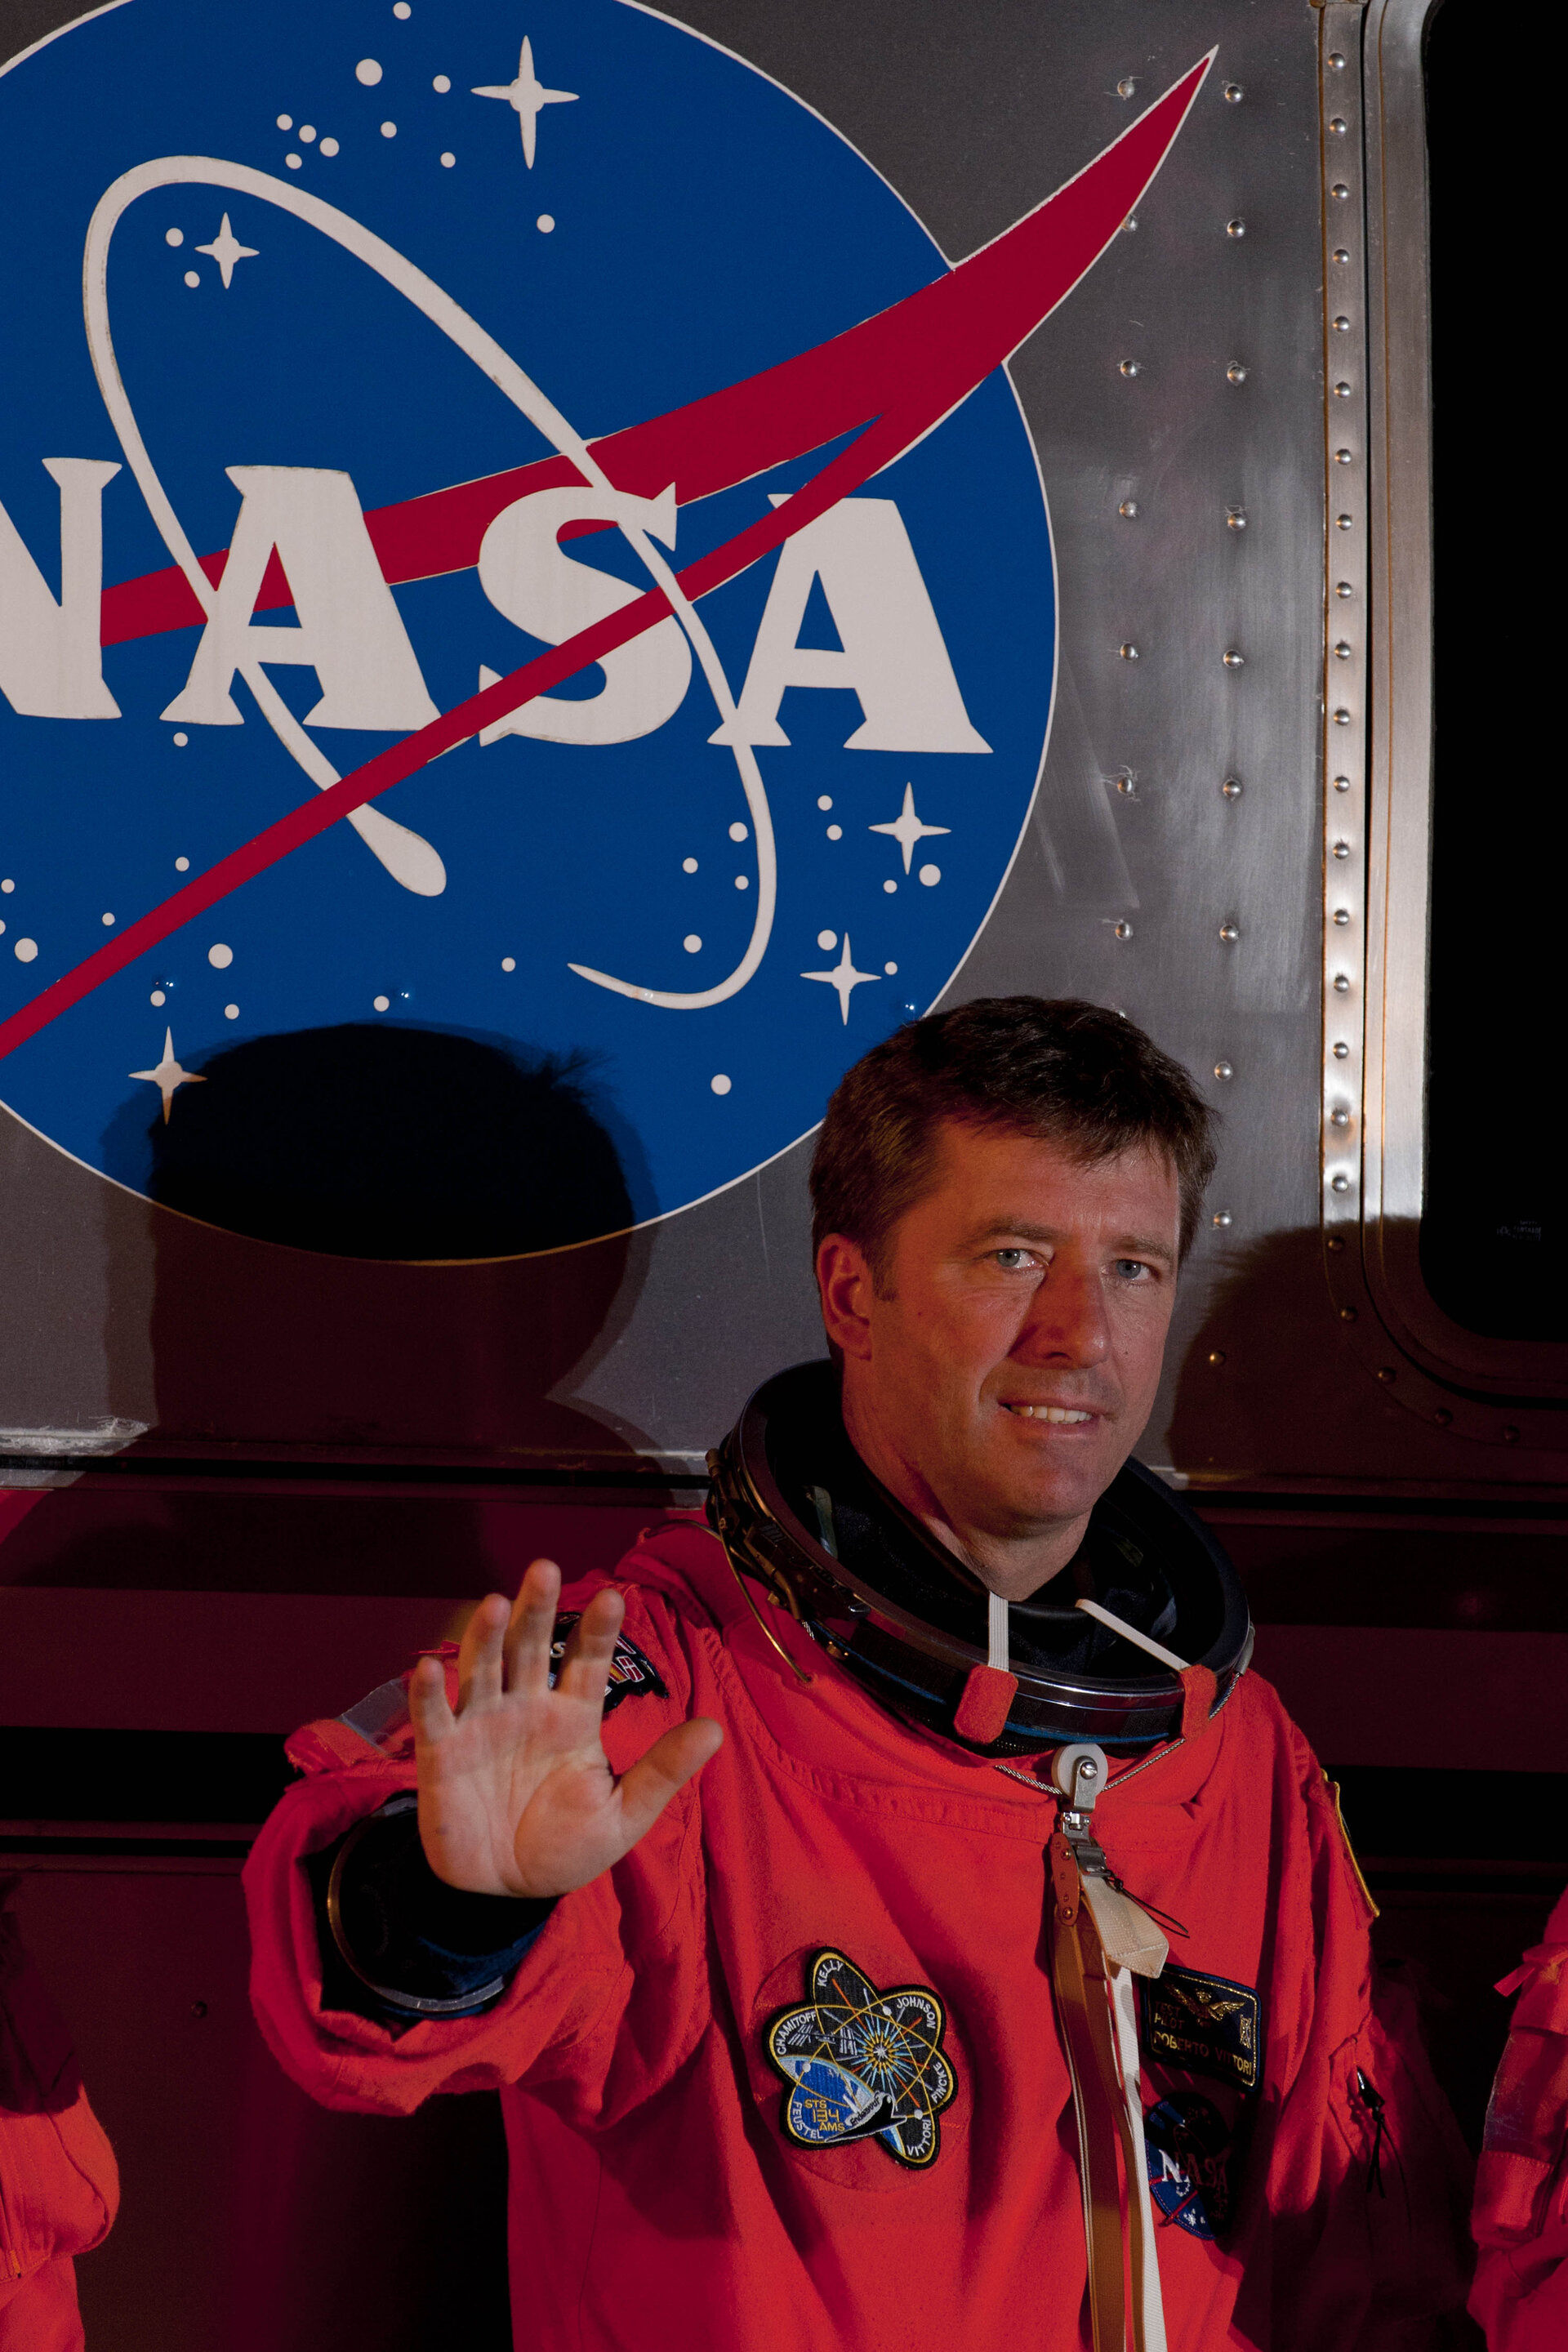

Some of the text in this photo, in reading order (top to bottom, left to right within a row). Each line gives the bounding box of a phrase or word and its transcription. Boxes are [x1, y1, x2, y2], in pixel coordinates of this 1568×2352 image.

[0, 457, 994, 753] NASA
[817, 1959, 844, 1987] KELLY
[897, 1996, 937, 2029] JOHNSON
[1153, 2012, 1186, 2030] PILOT
[776, 2010, 817, 2056] CHAMITOFF
[1153, 2030, 1253, 2076] ROBERTO VITTORI
[792, 2101, 824, 2140] FEUSTEL
[804, 2099, 827, 2109] STS
[813, 2109, 840, 2123] 134
[819, 2122, 846, 2132] AMS
[906, 2119, 932, 2157] VITTORI
